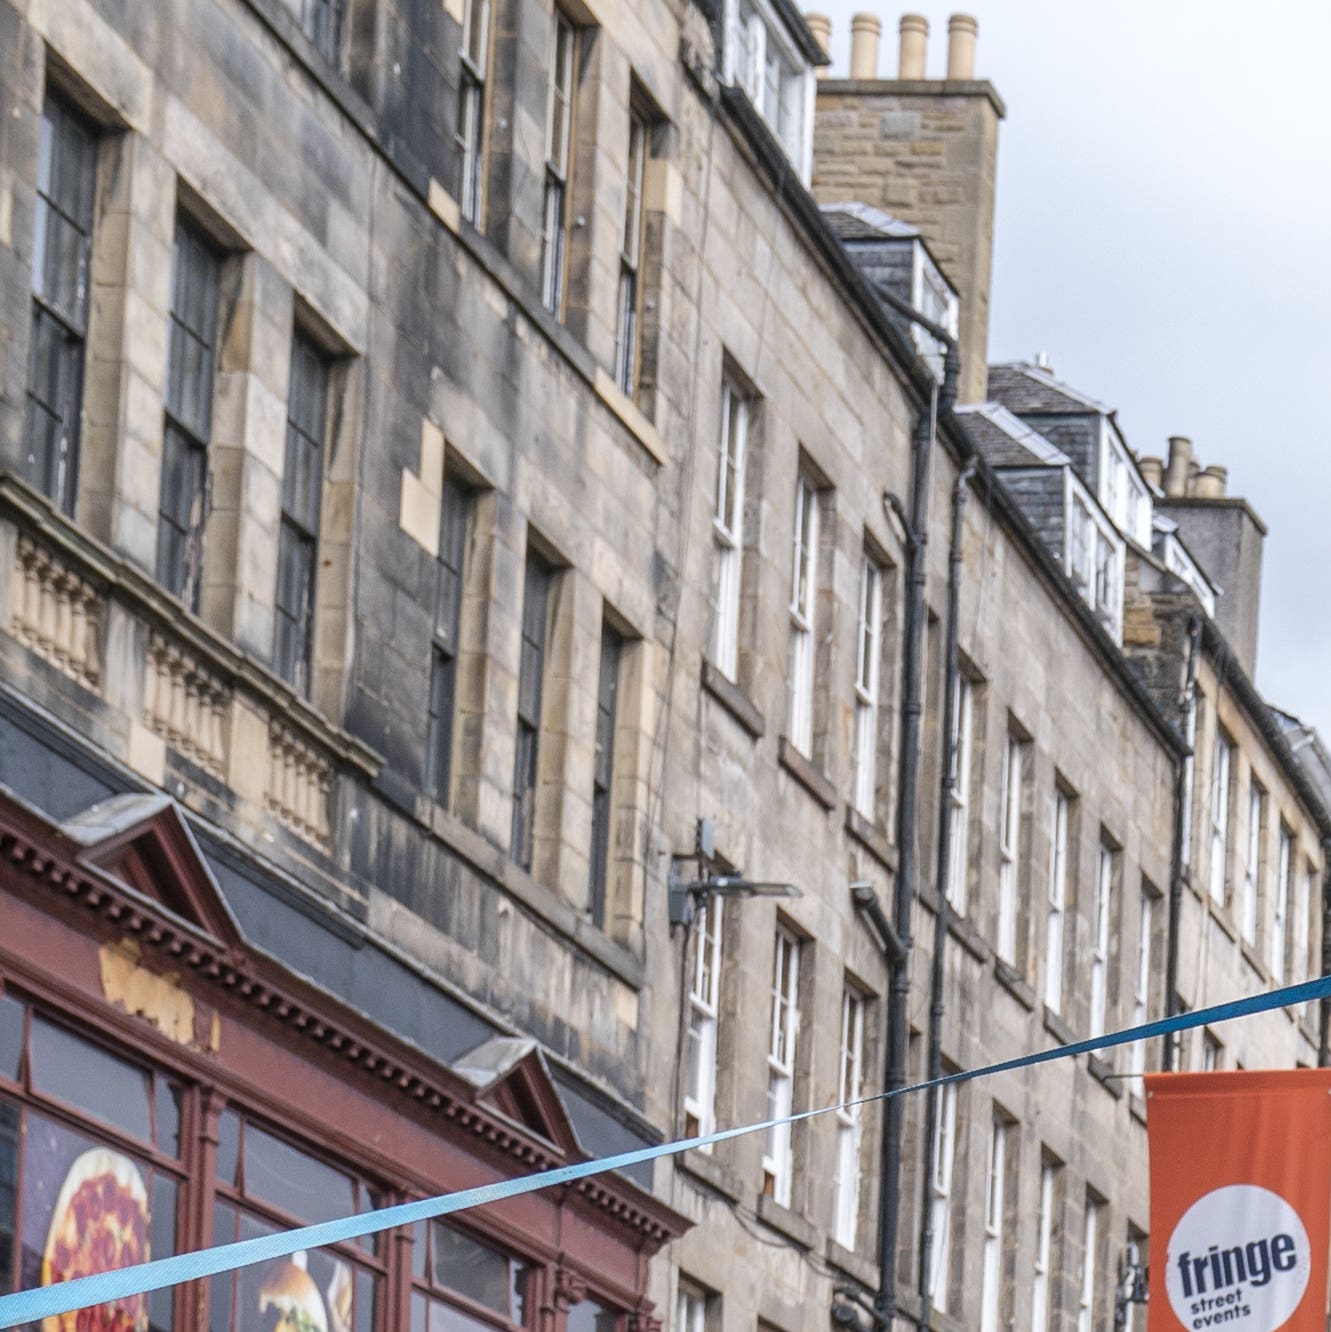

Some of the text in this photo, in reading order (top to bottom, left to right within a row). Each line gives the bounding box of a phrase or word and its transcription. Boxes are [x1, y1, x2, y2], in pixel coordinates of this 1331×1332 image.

[1177, 1233, 1298, 1299] fringe
[1190, 1289, 1243, 1315] street
[1192, 1304, 1252, 1330] events
